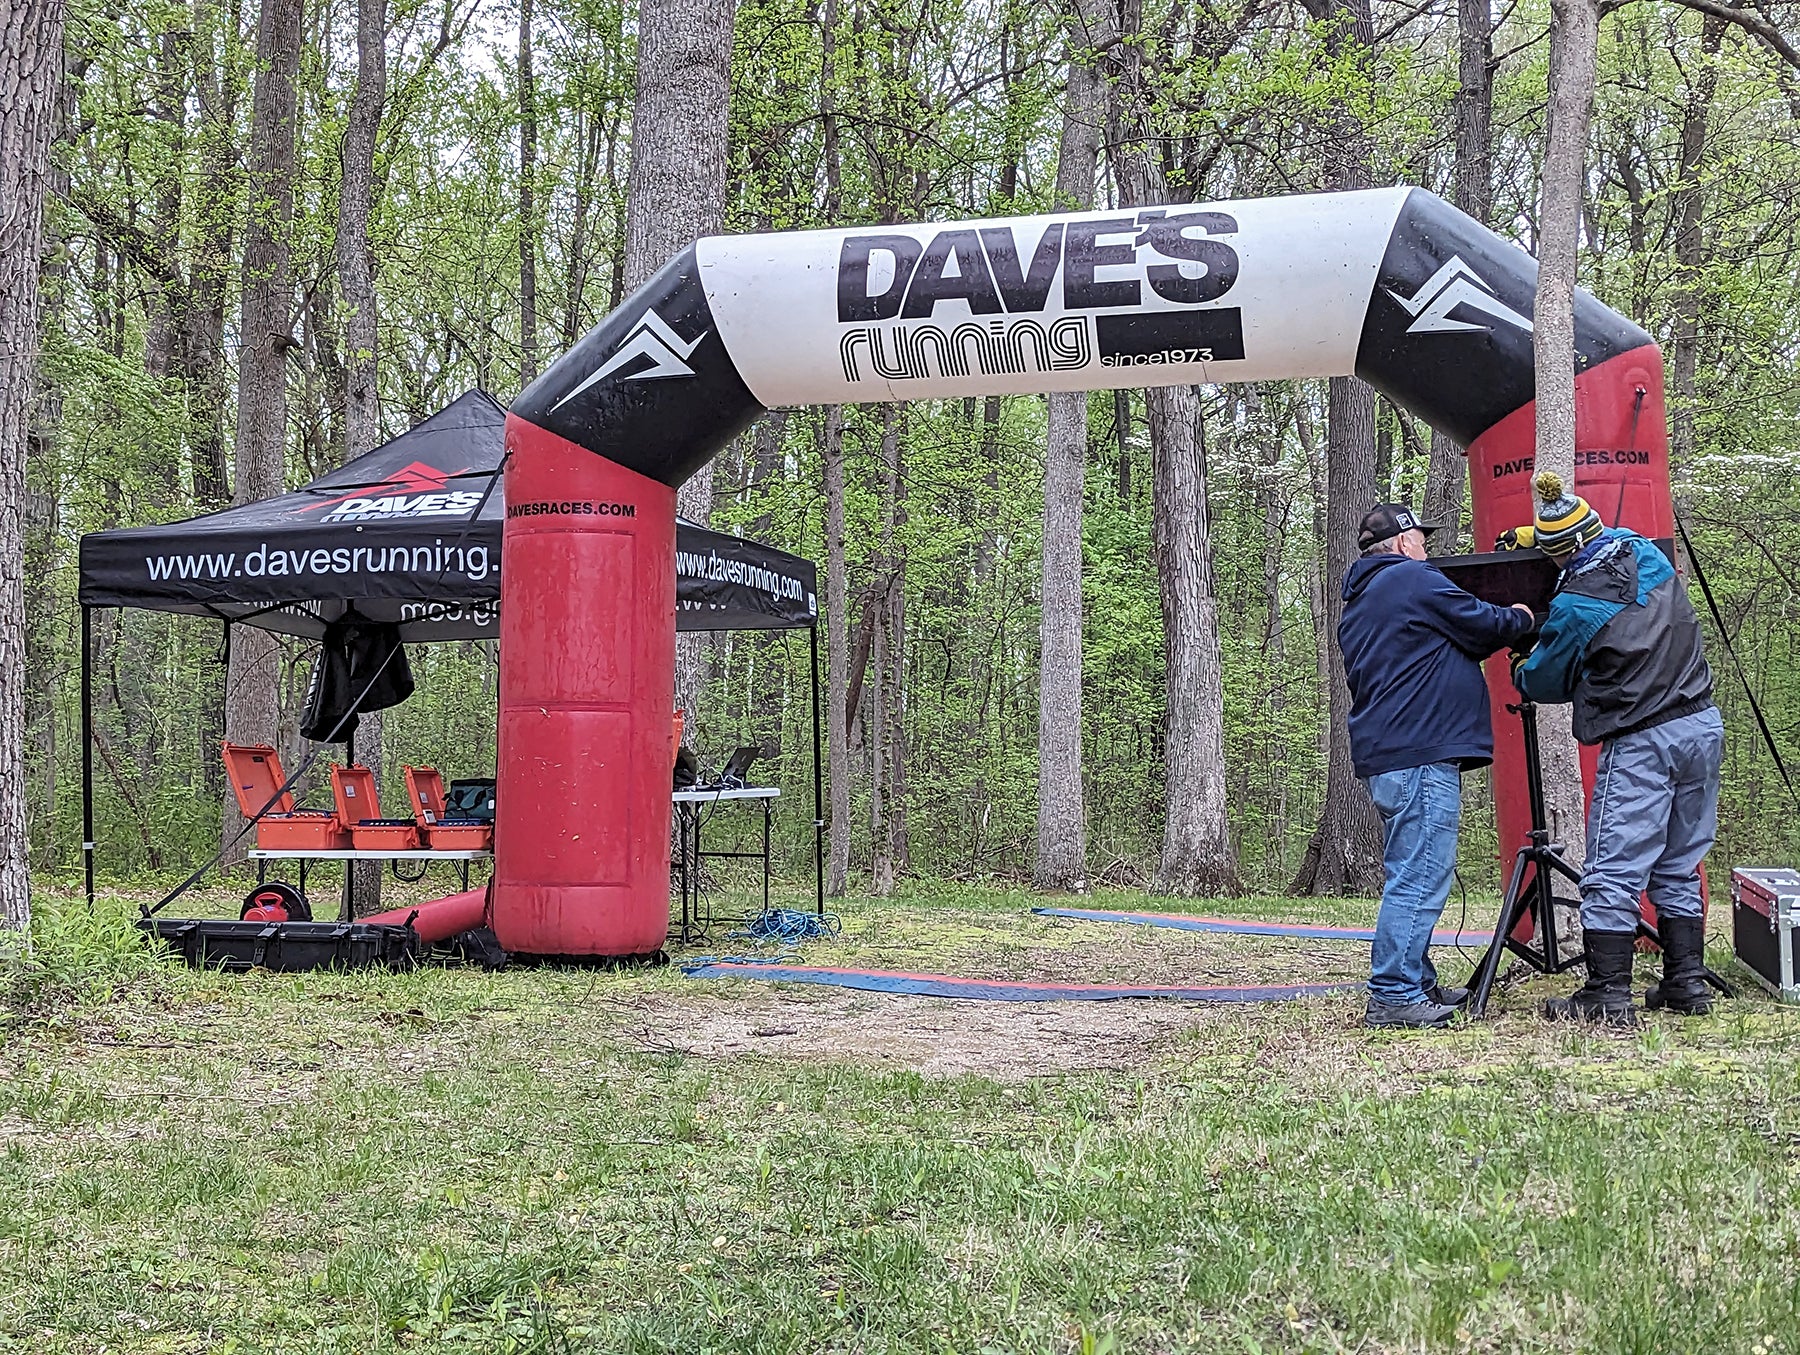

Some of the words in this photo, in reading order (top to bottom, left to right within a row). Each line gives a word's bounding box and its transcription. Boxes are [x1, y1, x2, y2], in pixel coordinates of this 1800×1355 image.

[838, 210, 1239, 323] DAVE'S
[840, 316, 1092, 382] running
[1493, 451, 1649, 478] DAVECES.COM
[331, 491, 484, 514] DAVE'S
[507, 502, 635, 519] DAVESRACES.COM
[146, 539, 499, 580] www.davesrunning.
[676, 549, 803, 602] www.davesrunning.com
